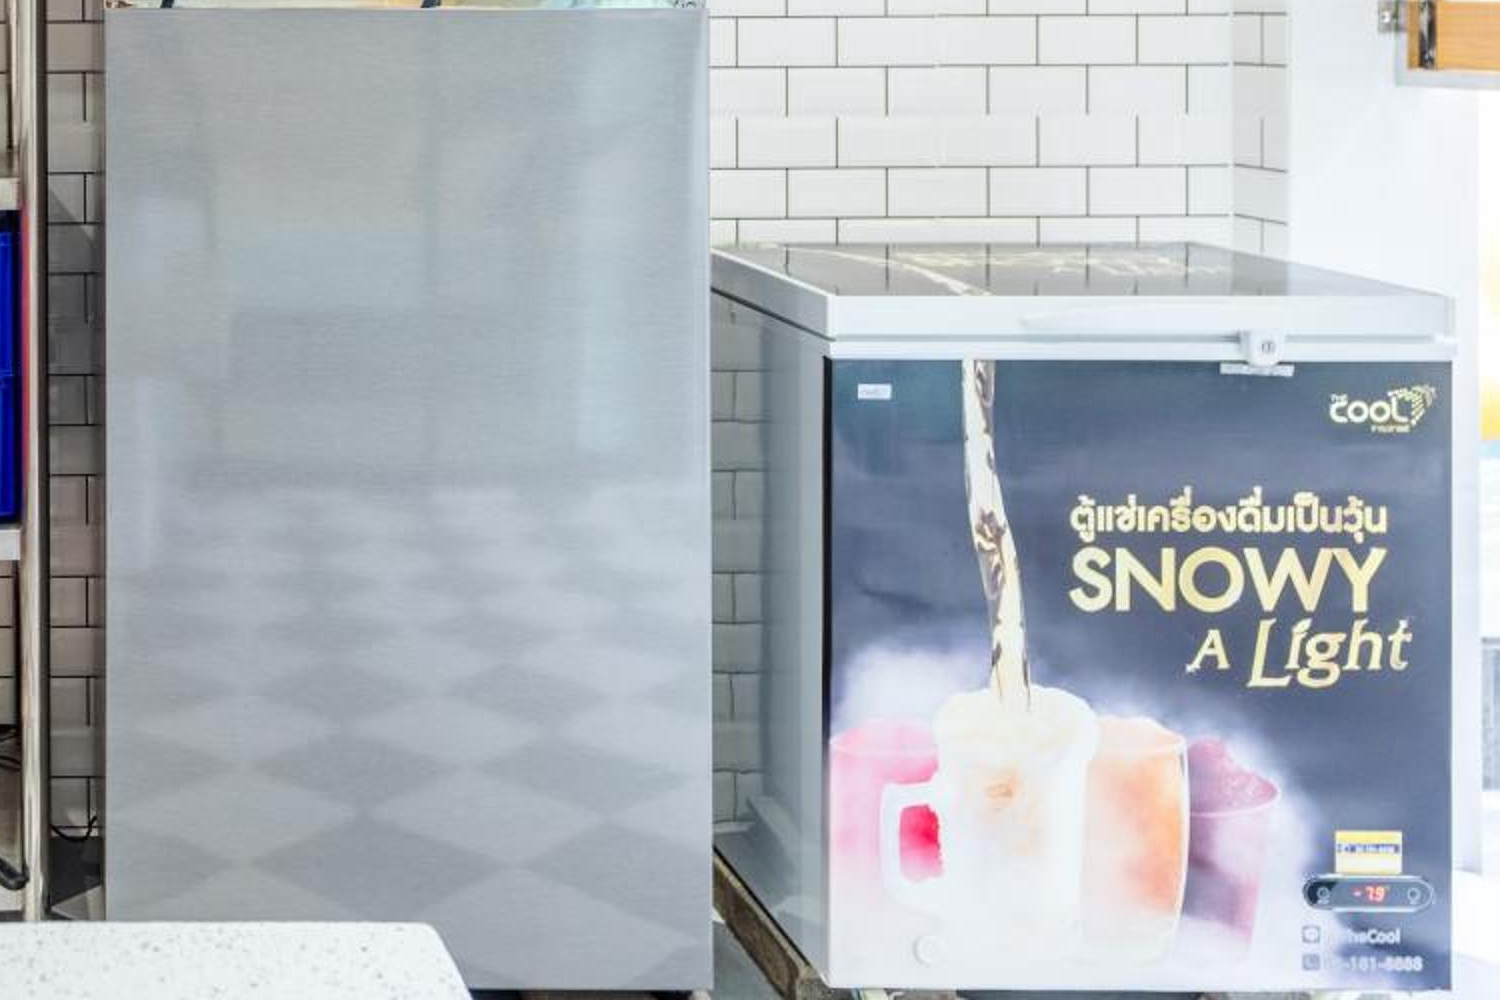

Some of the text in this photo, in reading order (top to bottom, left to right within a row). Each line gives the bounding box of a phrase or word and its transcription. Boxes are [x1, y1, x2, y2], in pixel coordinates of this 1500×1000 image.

[1069, 486, 1388, 544] ตู้แช่เครื่องดื่มเป็นวุ้น
[1068, 546, 1388, 613] SNOWY
[1185, 617, 1413, 689] A Light
